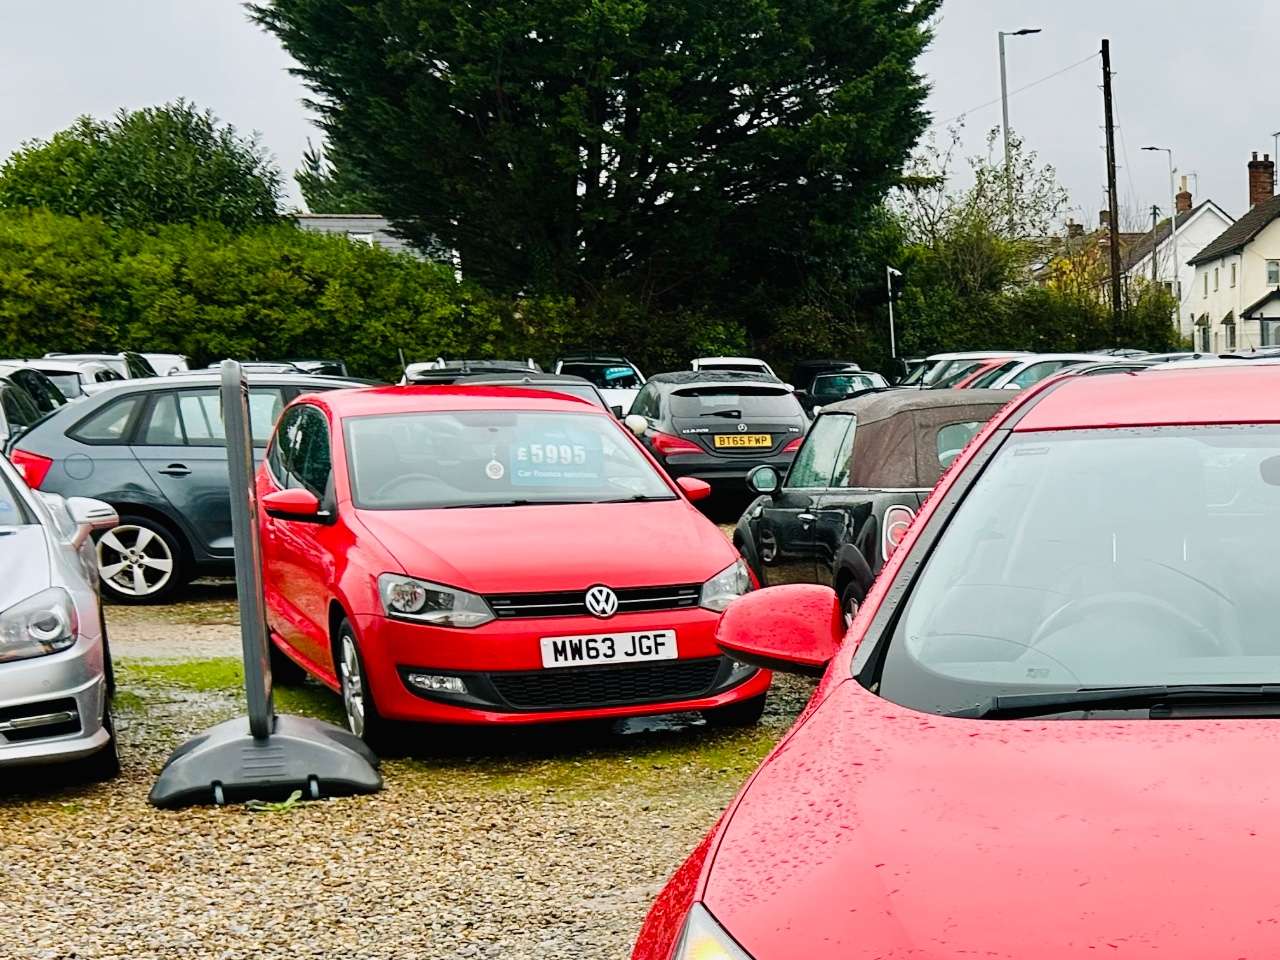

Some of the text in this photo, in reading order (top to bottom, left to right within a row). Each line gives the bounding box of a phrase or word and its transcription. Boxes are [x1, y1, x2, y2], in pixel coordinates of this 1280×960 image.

[719, 436, 767, 446] BT65 FWP
[517, 444, 586, 464] £5995
[552, 633, 667, 662] MW63 JGF
